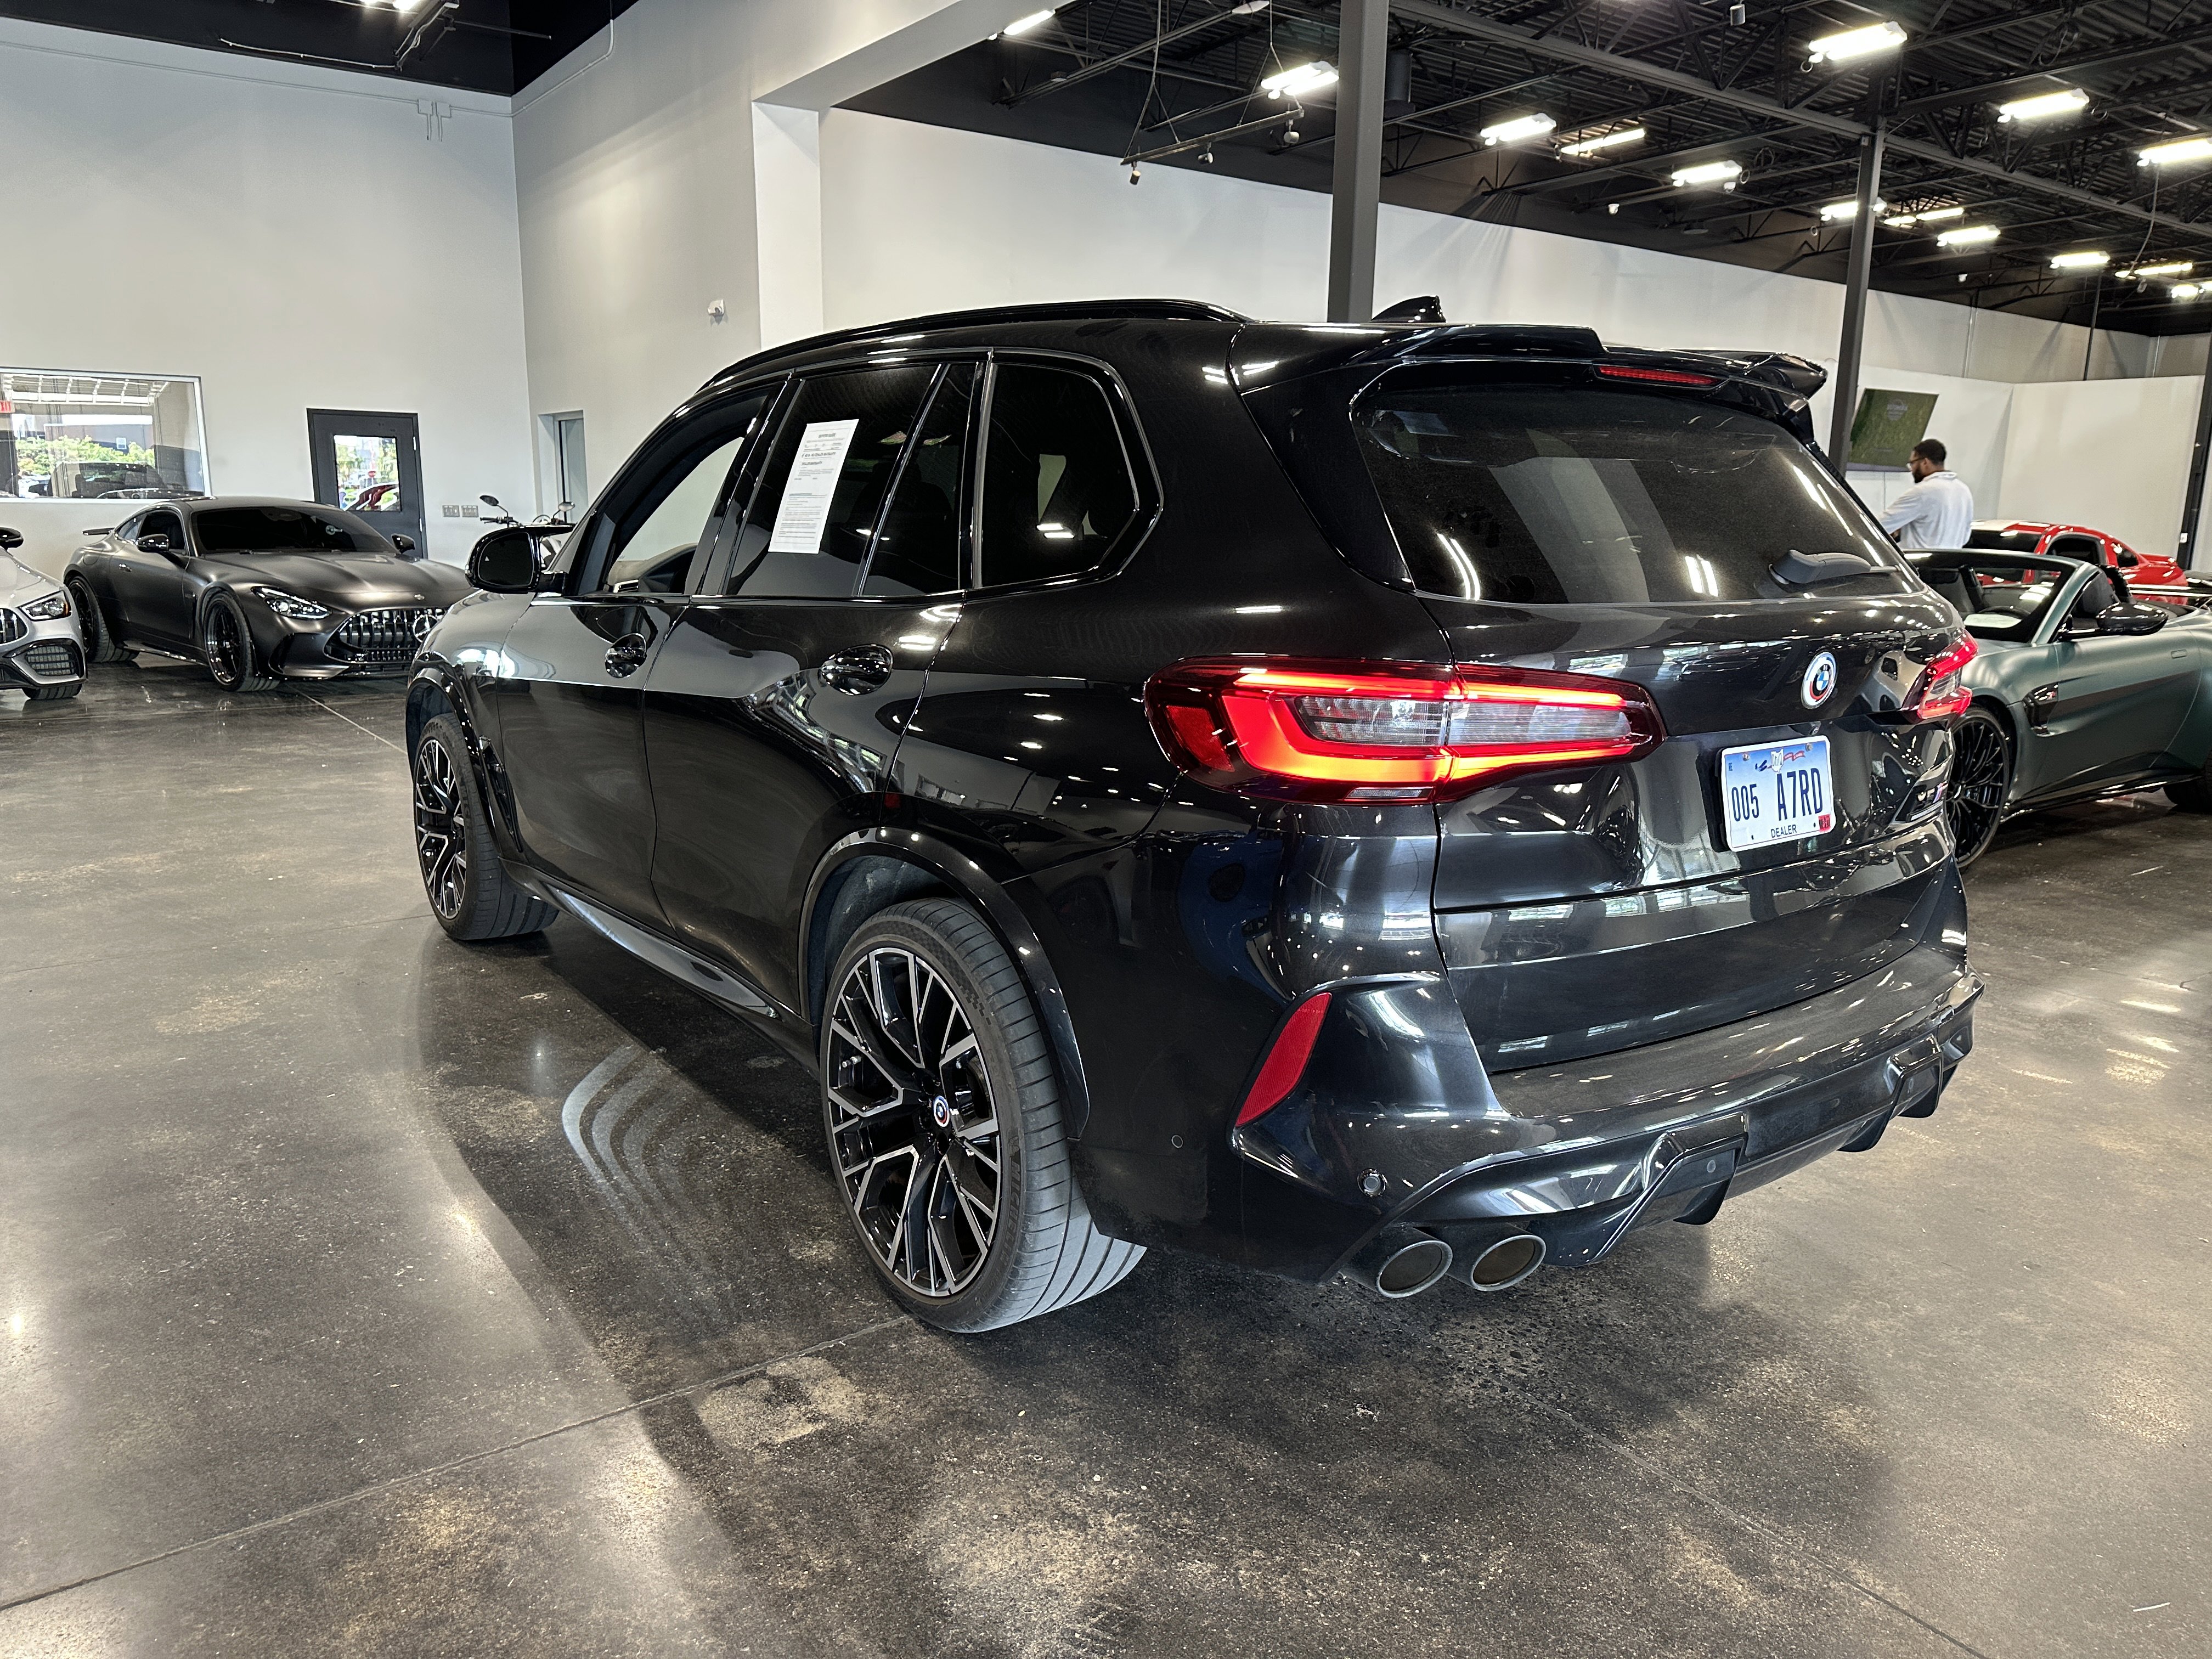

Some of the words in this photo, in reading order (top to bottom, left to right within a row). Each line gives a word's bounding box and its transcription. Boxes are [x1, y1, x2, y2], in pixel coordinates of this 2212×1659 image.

[0, 401, 11, 412] XIT
[1731, 783, 1759, 822] 005
[1777, 768, 1823, 821] A7RD
[1771, 824, 1797, 838] DEALER
[1000, 1160, 1020, 1266] MICHELIN
